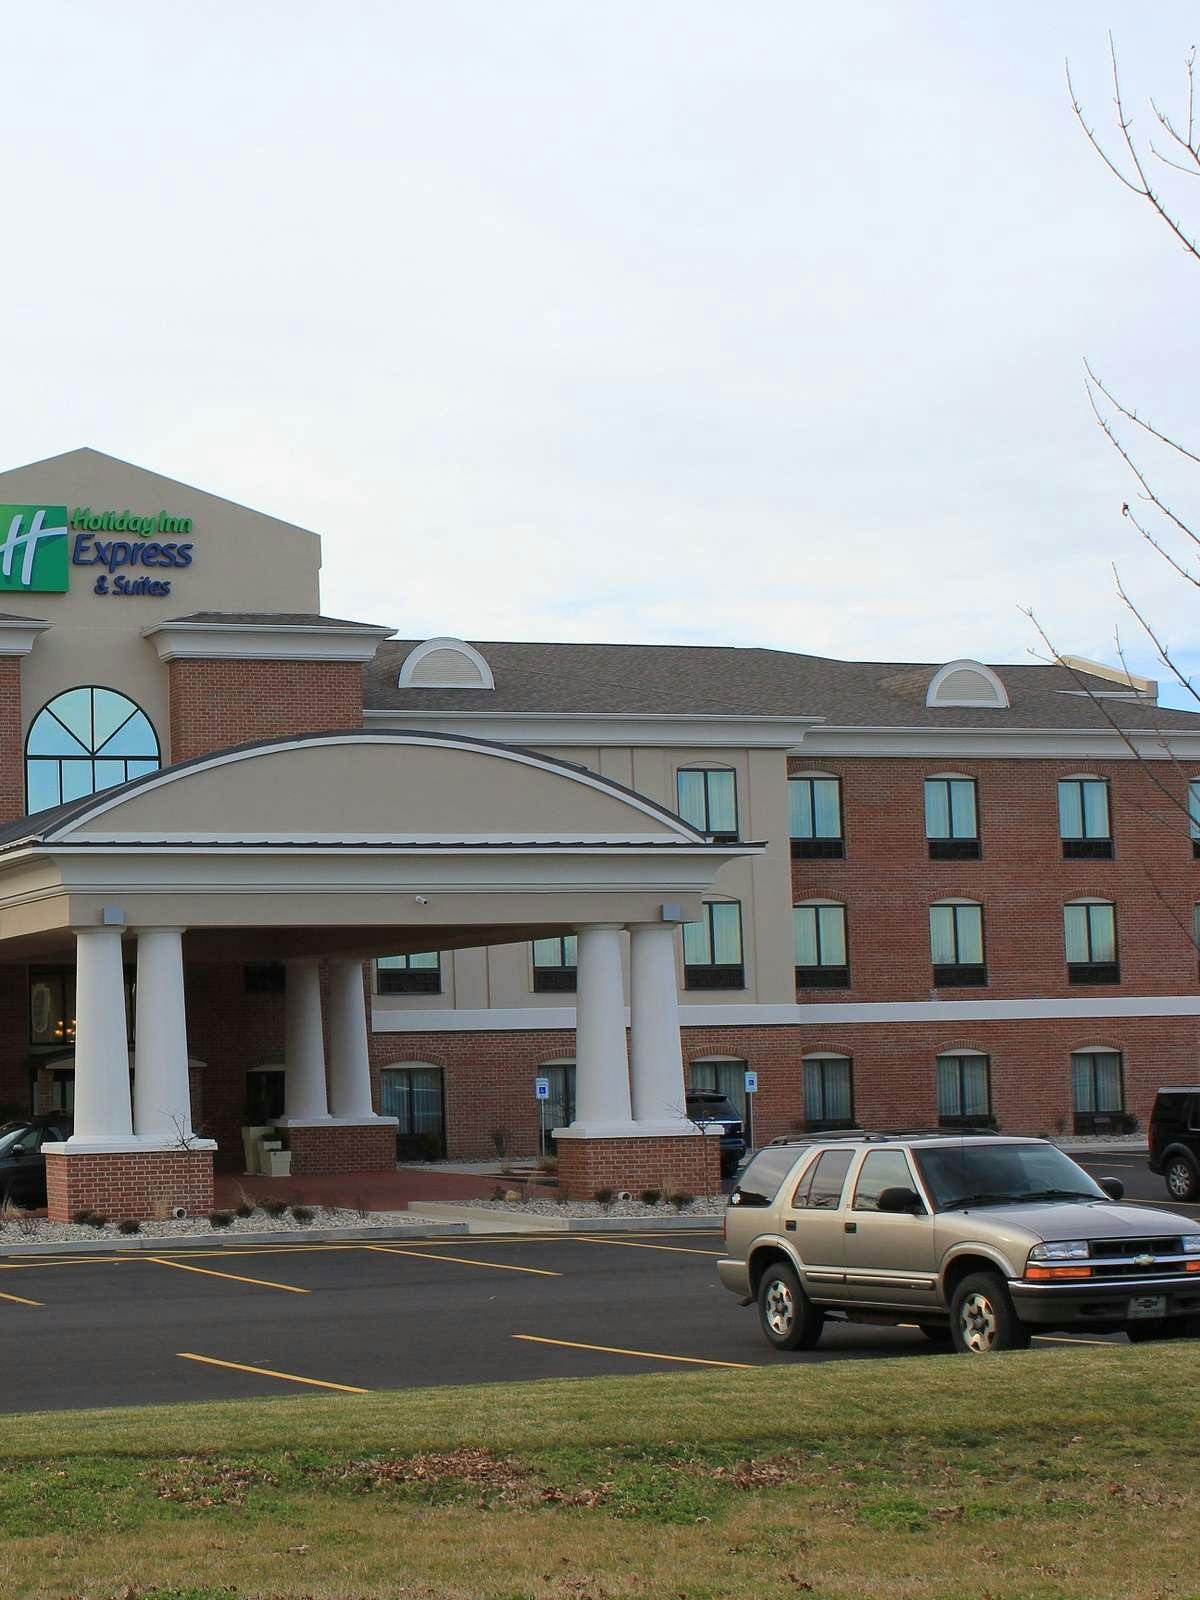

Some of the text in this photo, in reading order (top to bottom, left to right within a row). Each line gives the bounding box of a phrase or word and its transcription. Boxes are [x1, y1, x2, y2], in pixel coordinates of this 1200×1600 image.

[71, 507, 193, 537] Holiday Inn
[72, 533, 193, 573] Express
[94, 575, 171, 596] & Suites
